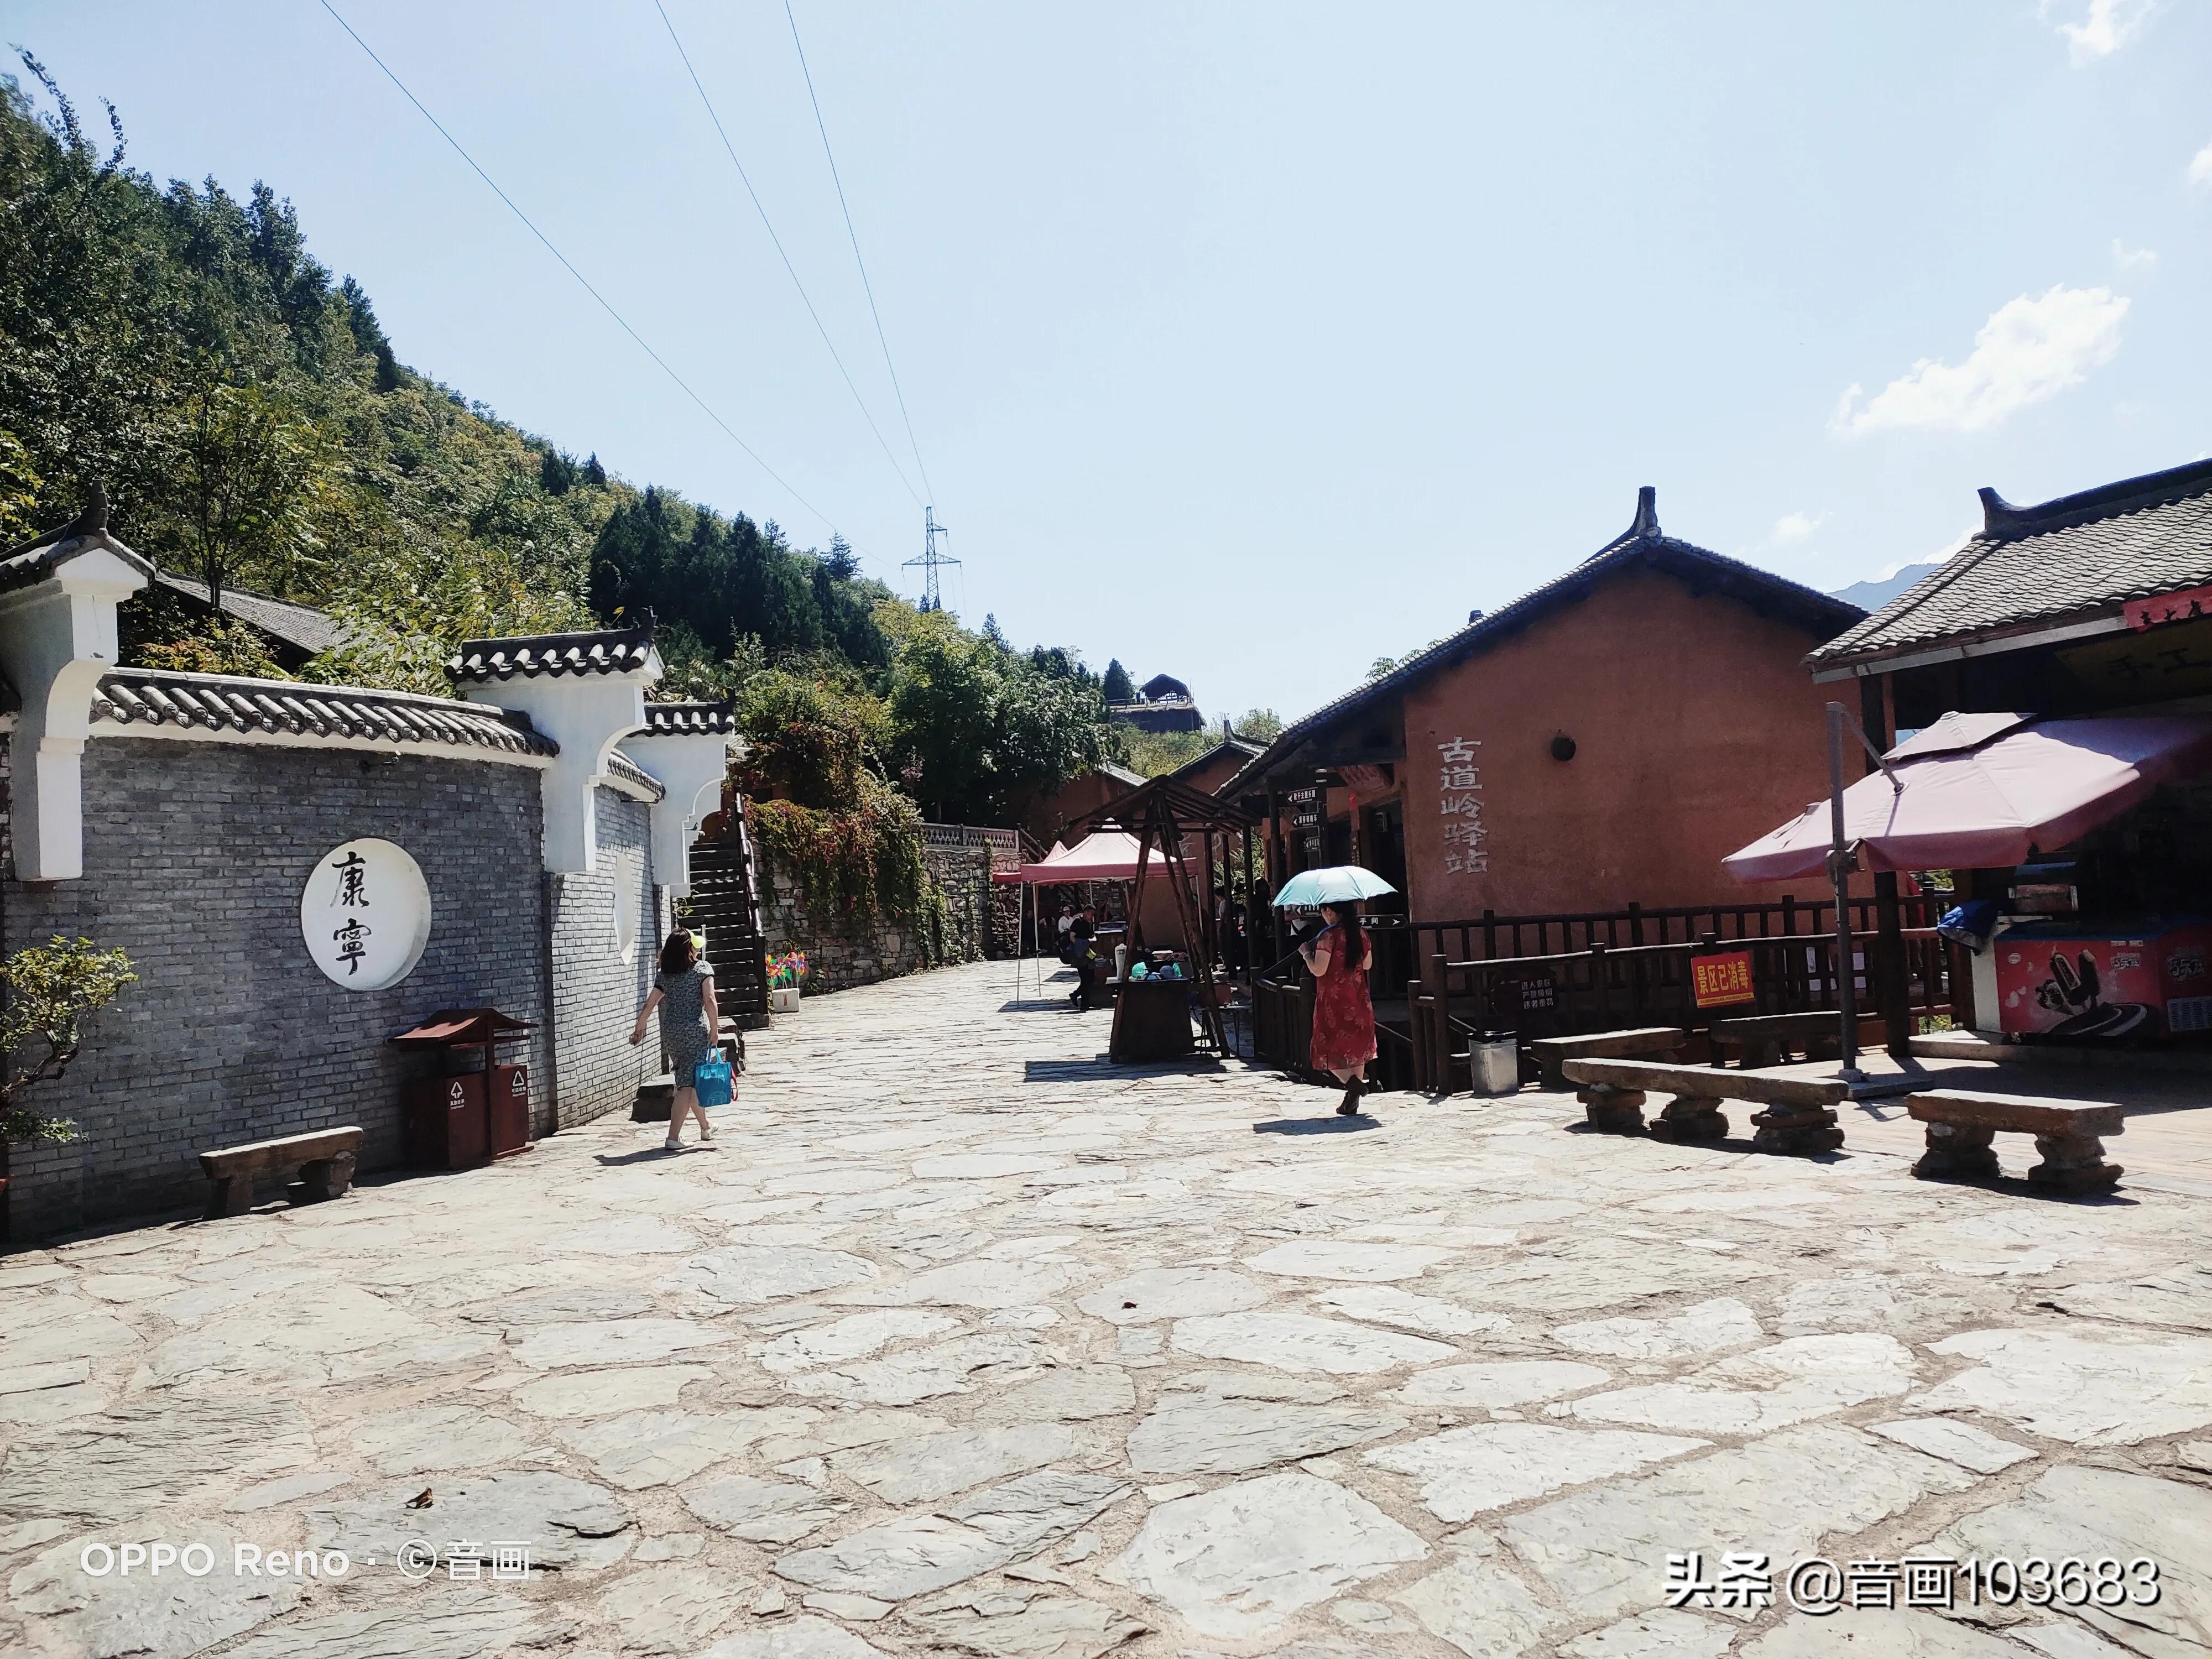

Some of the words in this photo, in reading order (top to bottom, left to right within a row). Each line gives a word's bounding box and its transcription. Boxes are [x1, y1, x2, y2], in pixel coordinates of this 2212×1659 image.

[1437, 736, 1489, 874] 古道岭驿站
[1359, 917, 1379, 925] 手间
[1697, 960, 1749, 994] 景区已消毒
